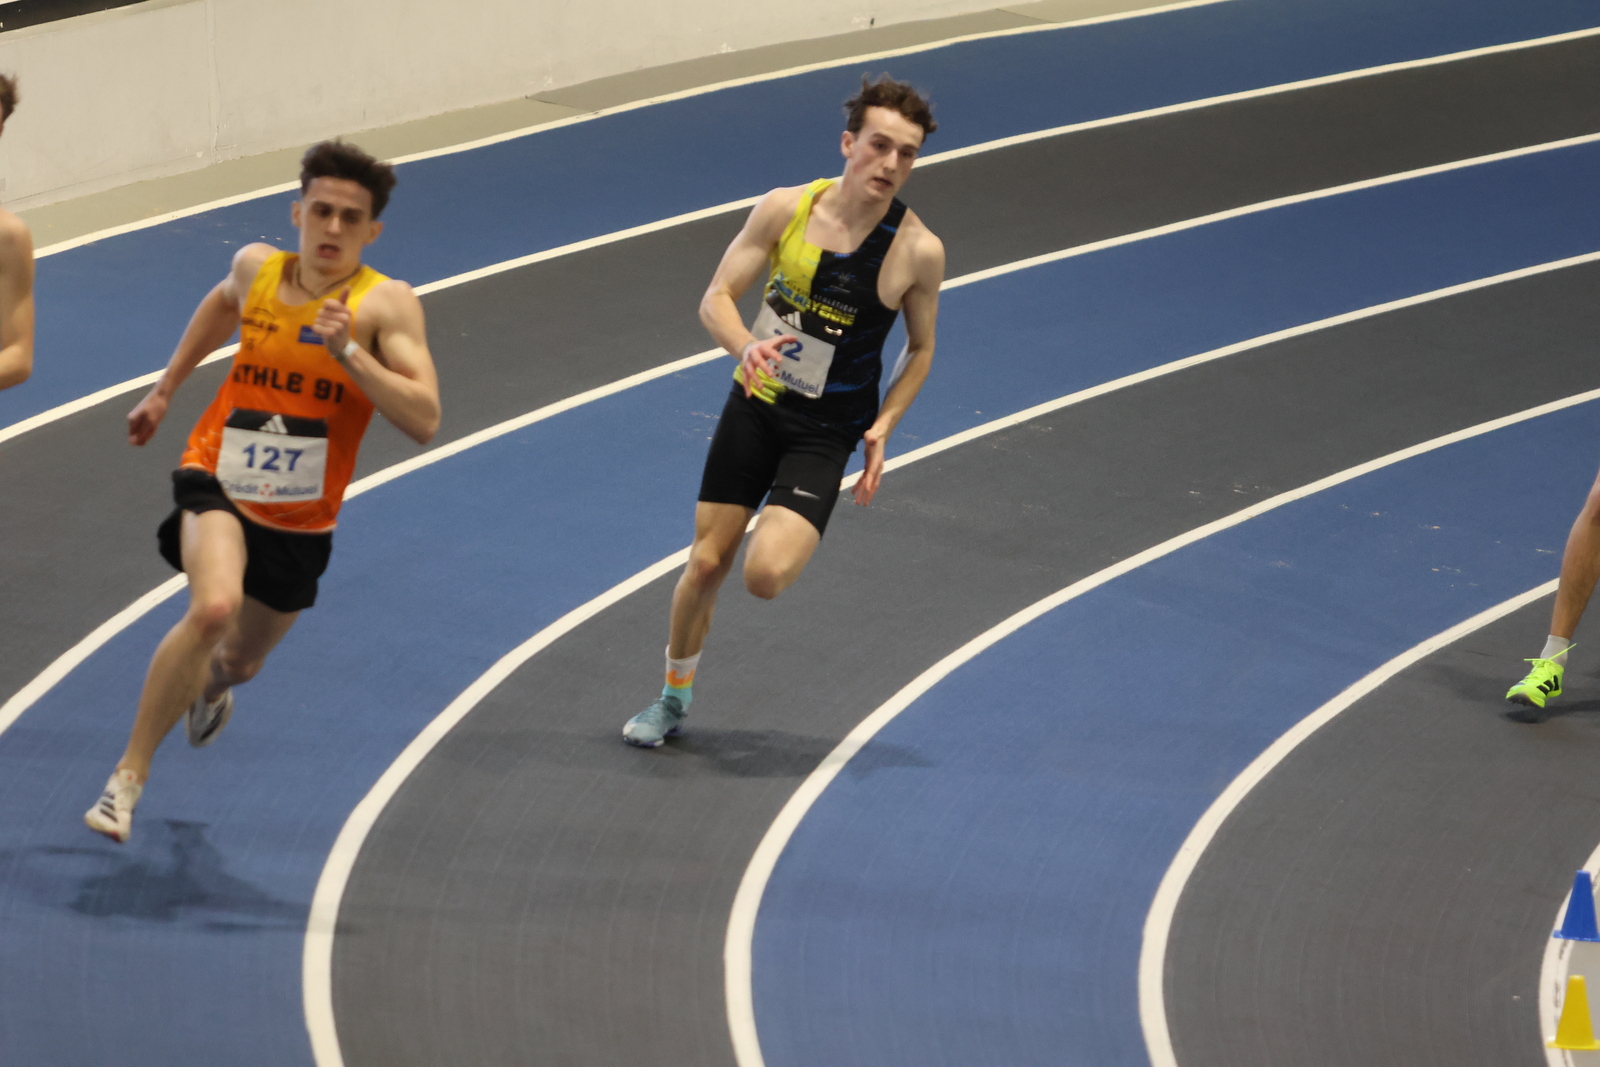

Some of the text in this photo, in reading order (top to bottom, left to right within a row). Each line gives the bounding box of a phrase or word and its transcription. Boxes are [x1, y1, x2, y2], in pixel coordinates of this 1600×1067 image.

[313, 378, 344, 403] 91
[780, 370, 819, 393] Mutuel
[242, 442, 304, 472] 127
